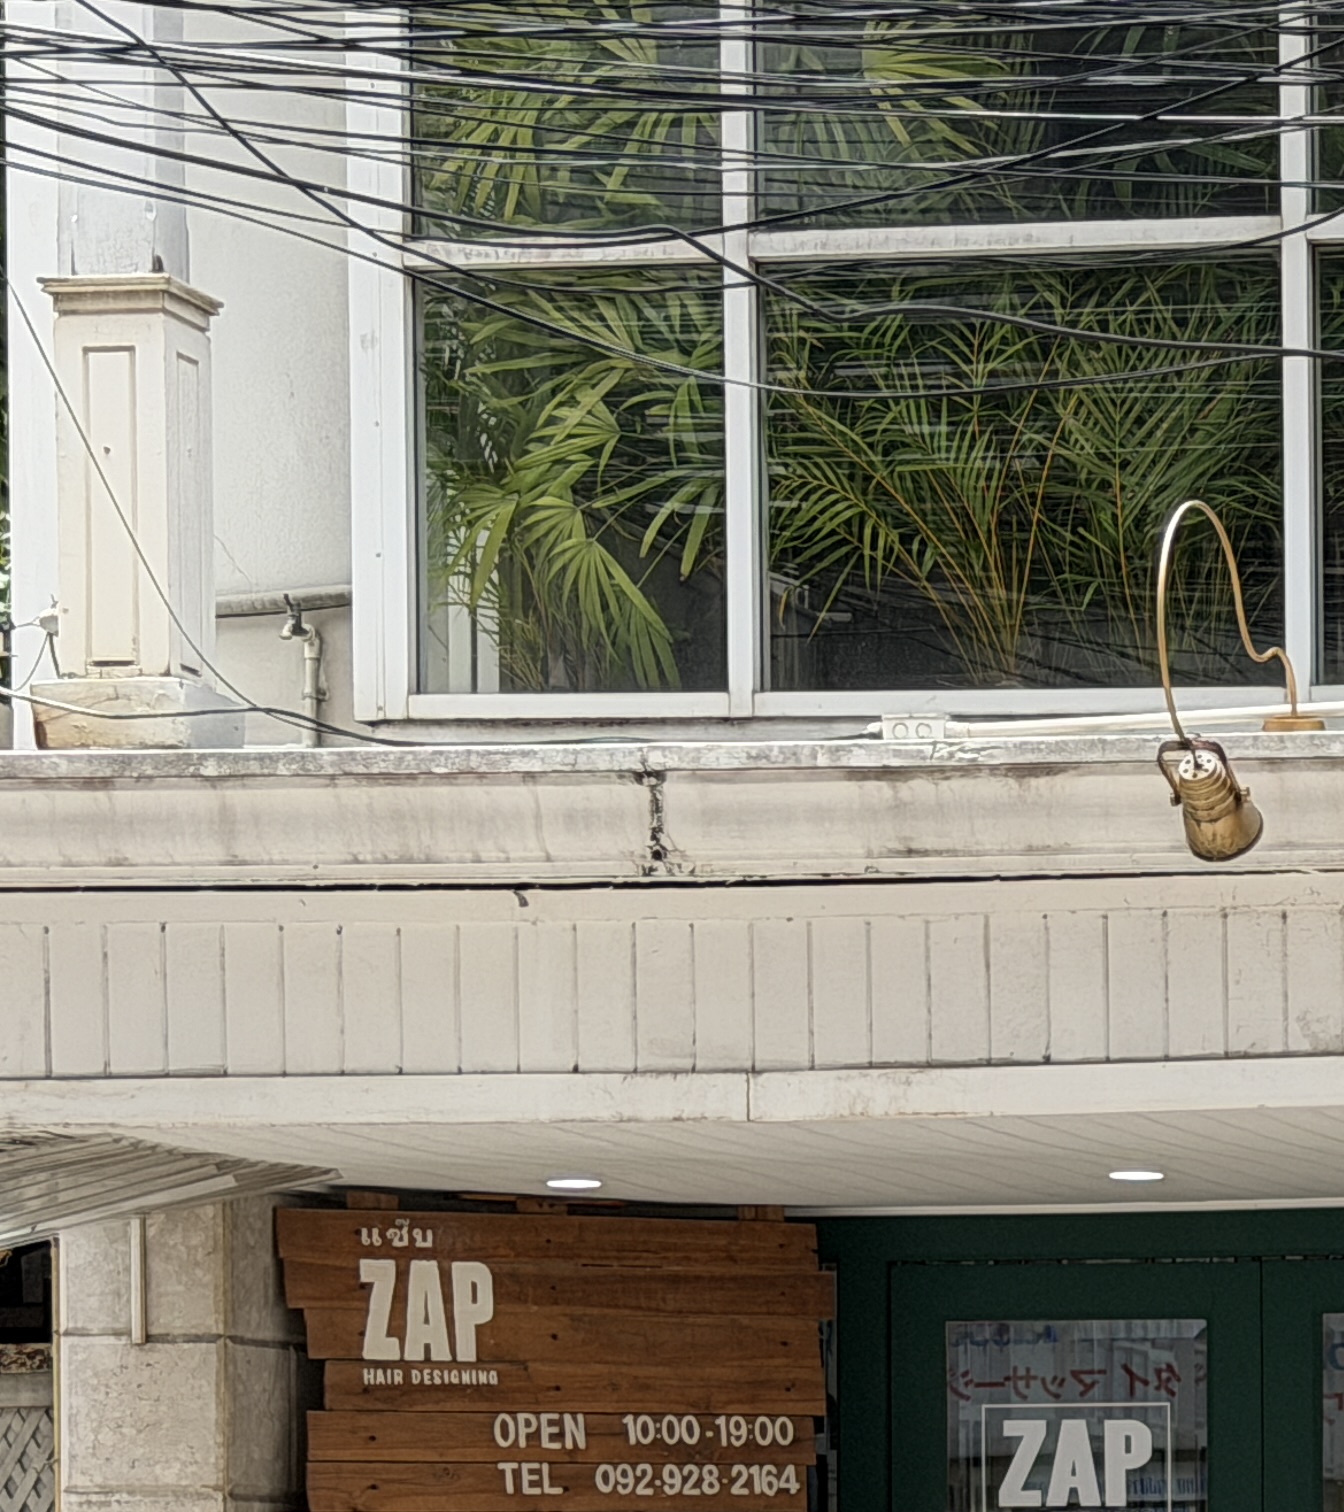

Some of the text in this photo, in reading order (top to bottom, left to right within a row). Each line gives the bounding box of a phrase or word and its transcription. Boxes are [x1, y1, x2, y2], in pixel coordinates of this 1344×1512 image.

[359, 1258, 494, 1362] ZAP
[363, 1367, 499, 1386] HAIR DESIGNING
[493, 1412, 587, 1450] OPEN
[497, 1462, 564, 1495] TEL
[998, 1418, 1153, 1508] ZAP
